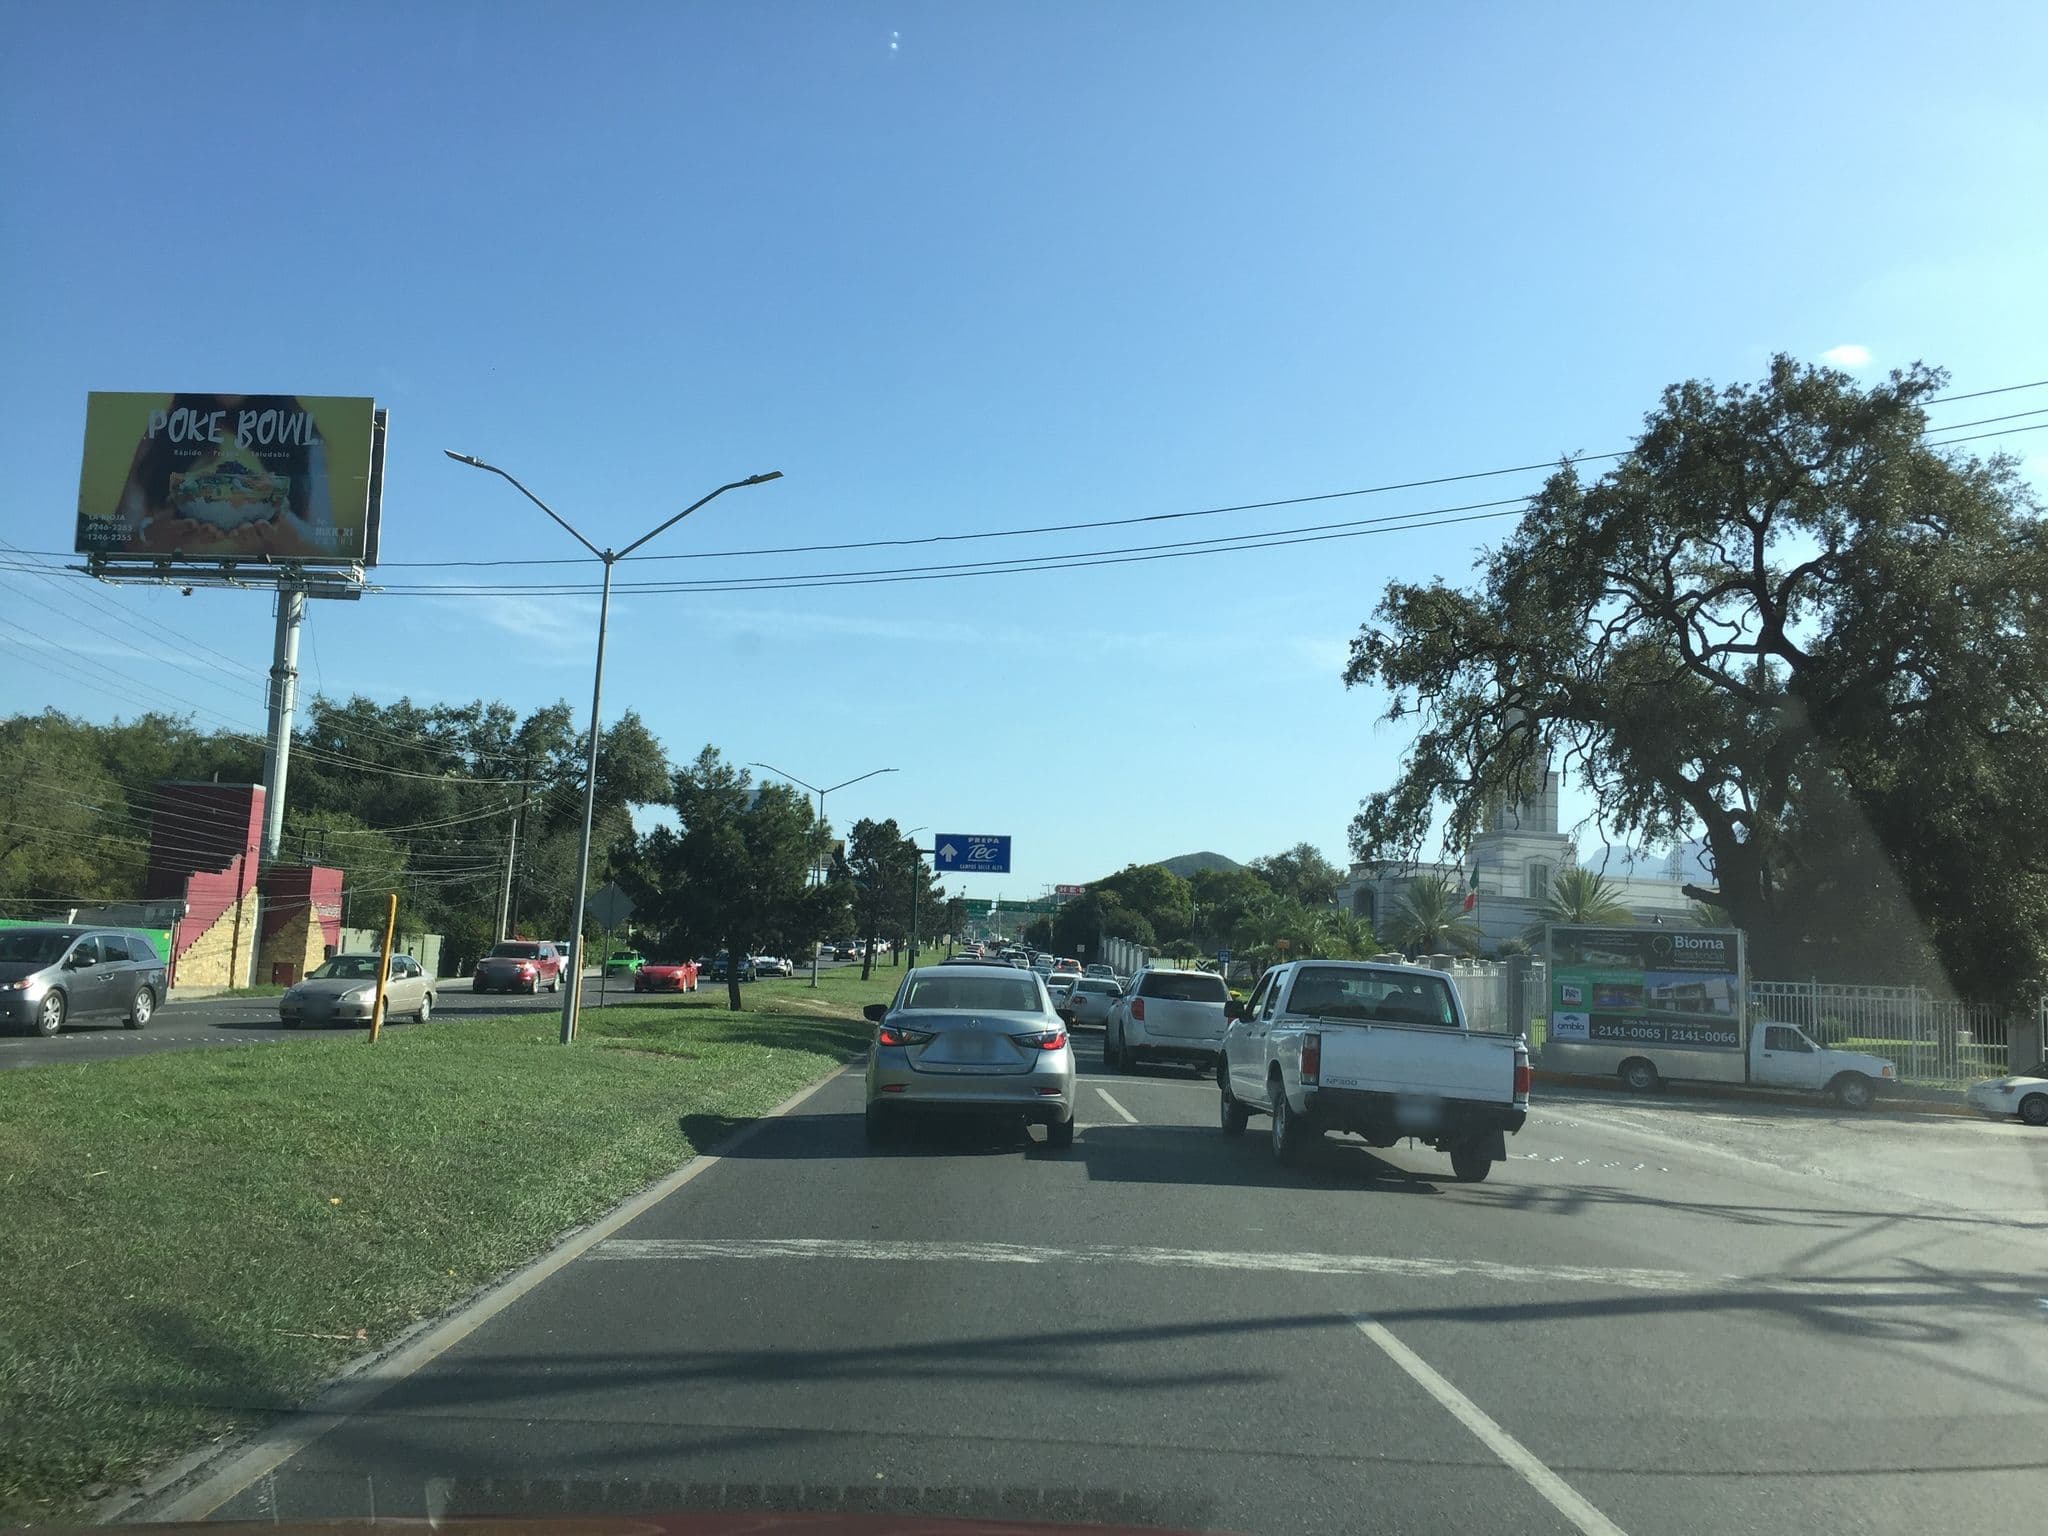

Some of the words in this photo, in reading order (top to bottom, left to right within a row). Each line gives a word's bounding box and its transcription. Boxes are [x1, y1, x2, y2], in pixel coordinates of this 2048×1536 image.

[148, 407, 226, 443] POKE
[234, 408, 321, 449] BOWL
[967, 844, 999, 859] Tec
[1674, 936, 1724, 949] Bioma
[1598, 1026, 1661, 1039] 2141-0065
[1671, 1030, 1736, 1043] 2141-0066
